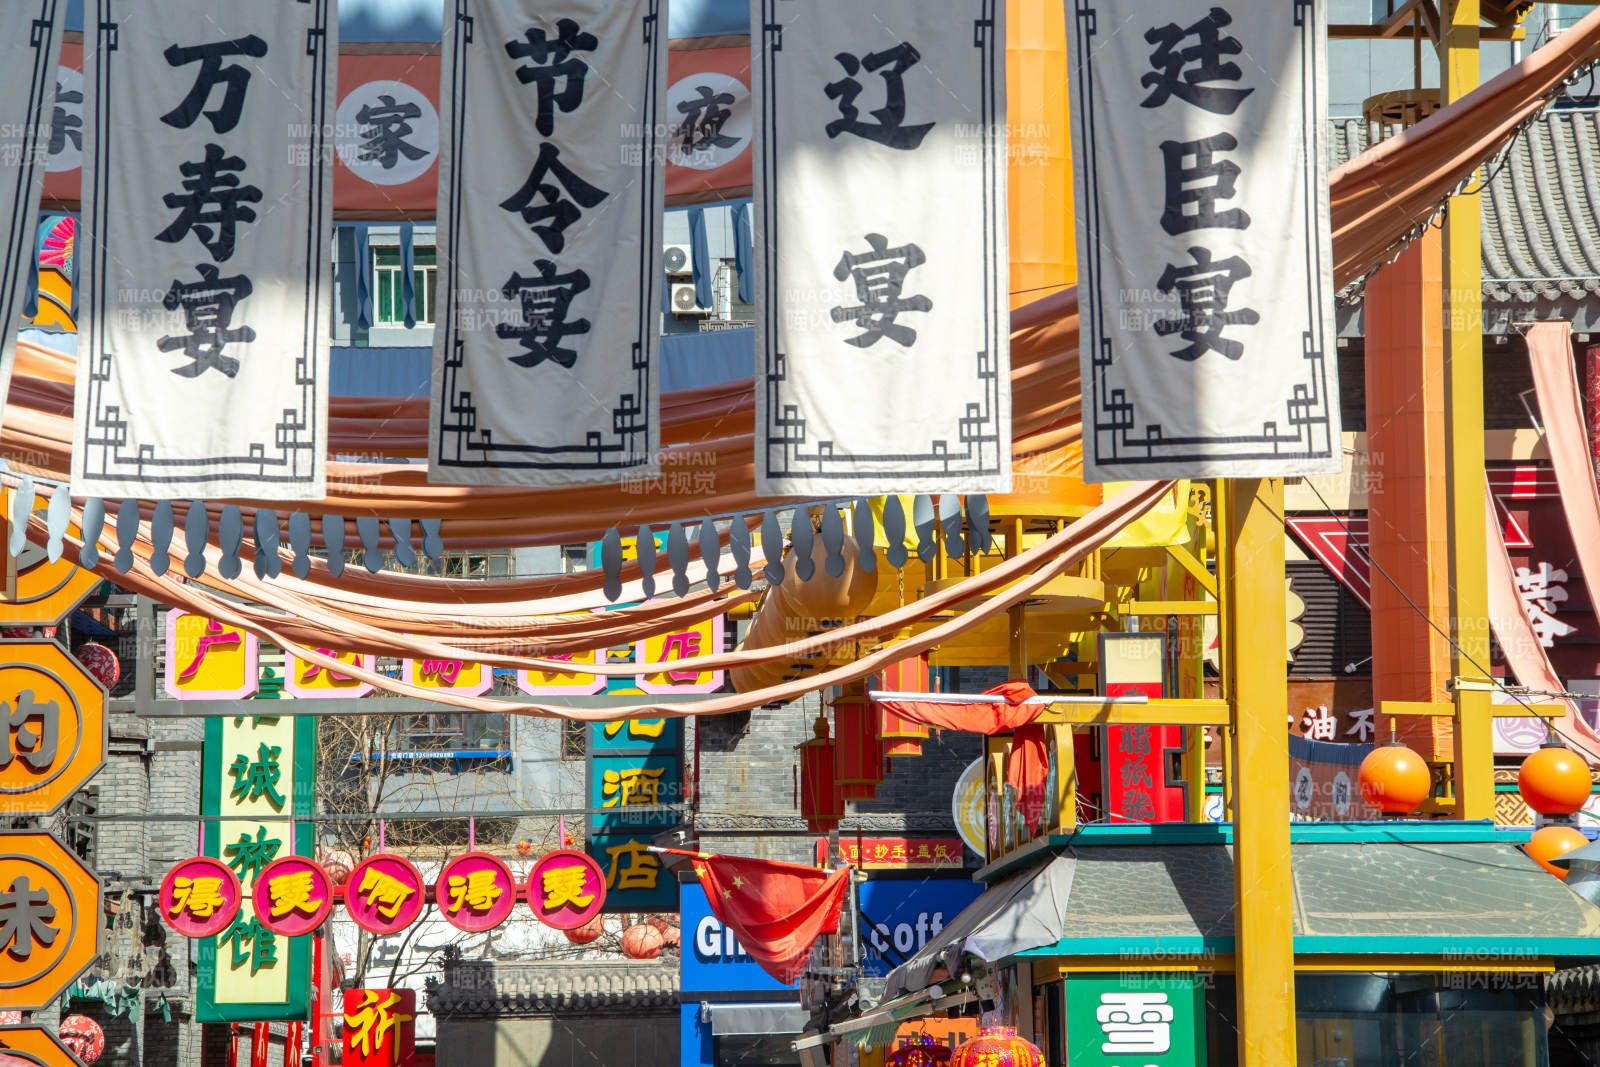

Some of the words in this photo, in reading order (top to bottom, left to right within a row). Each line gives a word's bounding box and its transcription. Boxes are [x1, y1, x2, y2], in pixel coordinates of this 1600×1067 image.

[154, 34, 268, 378] 万寿宴
[355, 95, 430, 169] 家
[677, 86, 742, 155] 夜
[496, 18, 610, 368] 节令宴
[824, 41, 936, 348] 辽宴
[1140, 7, 1260, 361] 廷臣宴
[1288, 704, 1374, 741] 油不
[1097, 993, 1173, 1053] 雪
